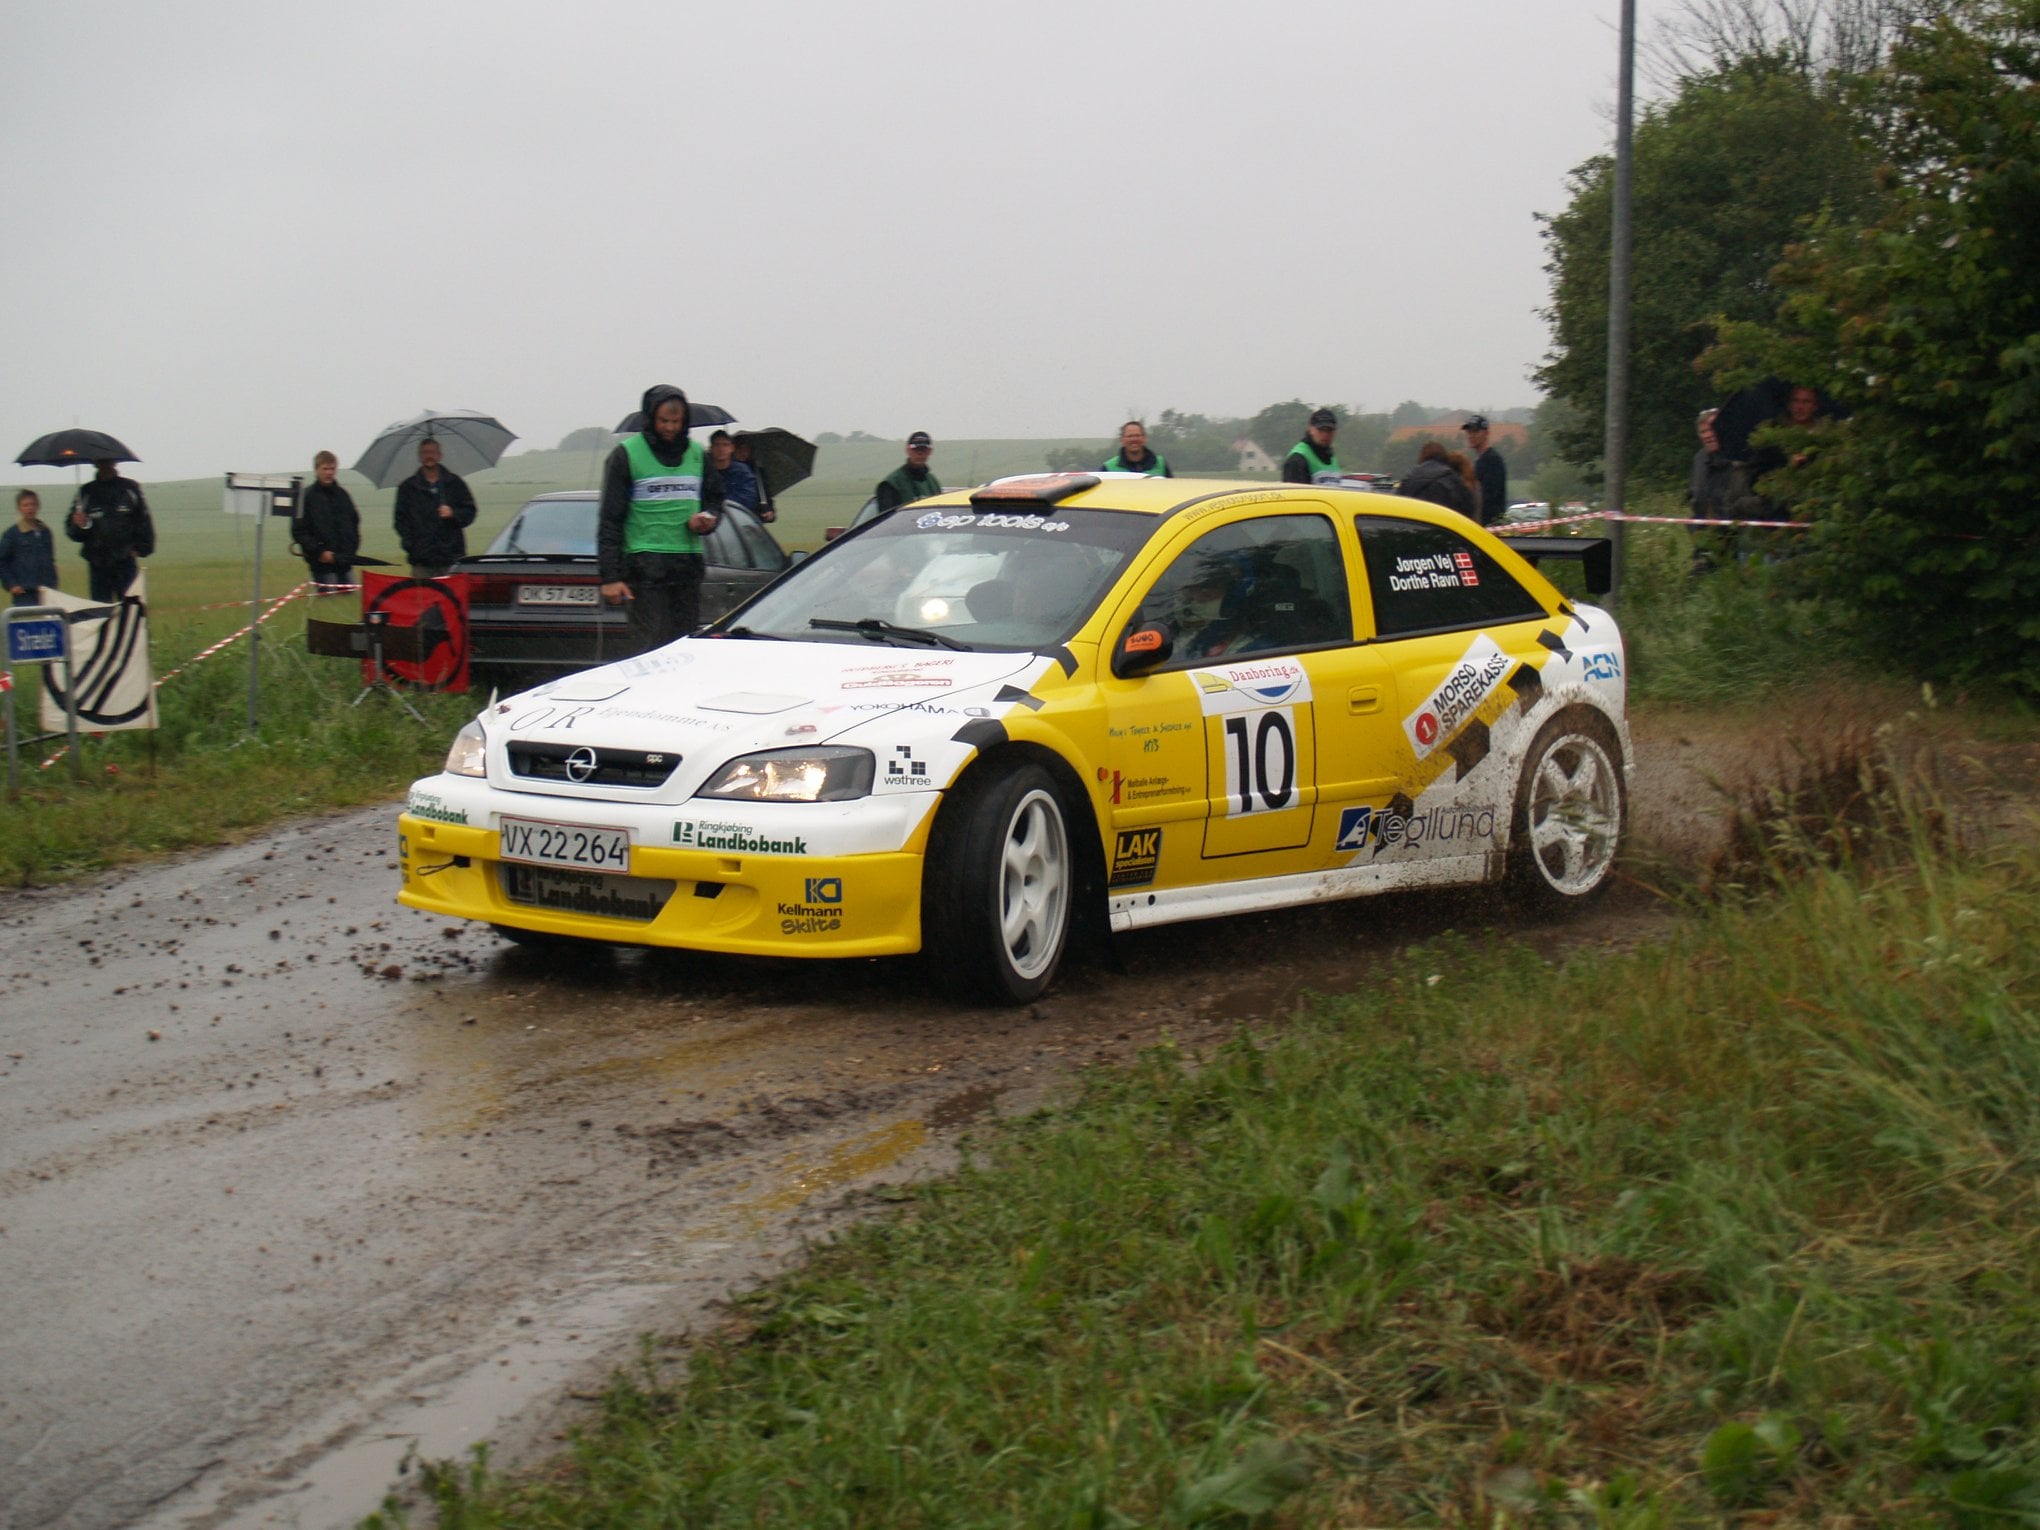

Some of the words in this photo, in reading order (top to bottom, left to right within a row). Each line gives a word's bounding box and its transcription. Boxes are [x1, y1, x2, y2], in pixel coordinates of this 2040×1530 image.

[976, 513, 1045, 529] tools
[1396, 557, 1435, 574] Jørgen
[1433, 554, 1455, 572] Vej
[1389, 574, 1430, 592] Dorthe
[1429, 572, 1459, 588] Ravn
[1441, 653, 1508, 732] SPAREKASSE
[1226, 711, 1294, 813] 10
[884, 775, 931, 786] wethree
[411, 800, 468, 825] Landbobank
[698, 820, 753, 836] Ringkjøbing
[1375, 803, 1494, 850] Tegllund
[504, 824, 533, 856] VX
[697, 831, 807, 854] Landbobank
[1117, 832, 1158, 858] LAK
[777, 902, 842, 916] Kellmann
[780, 917, 841, 935] Skilte
